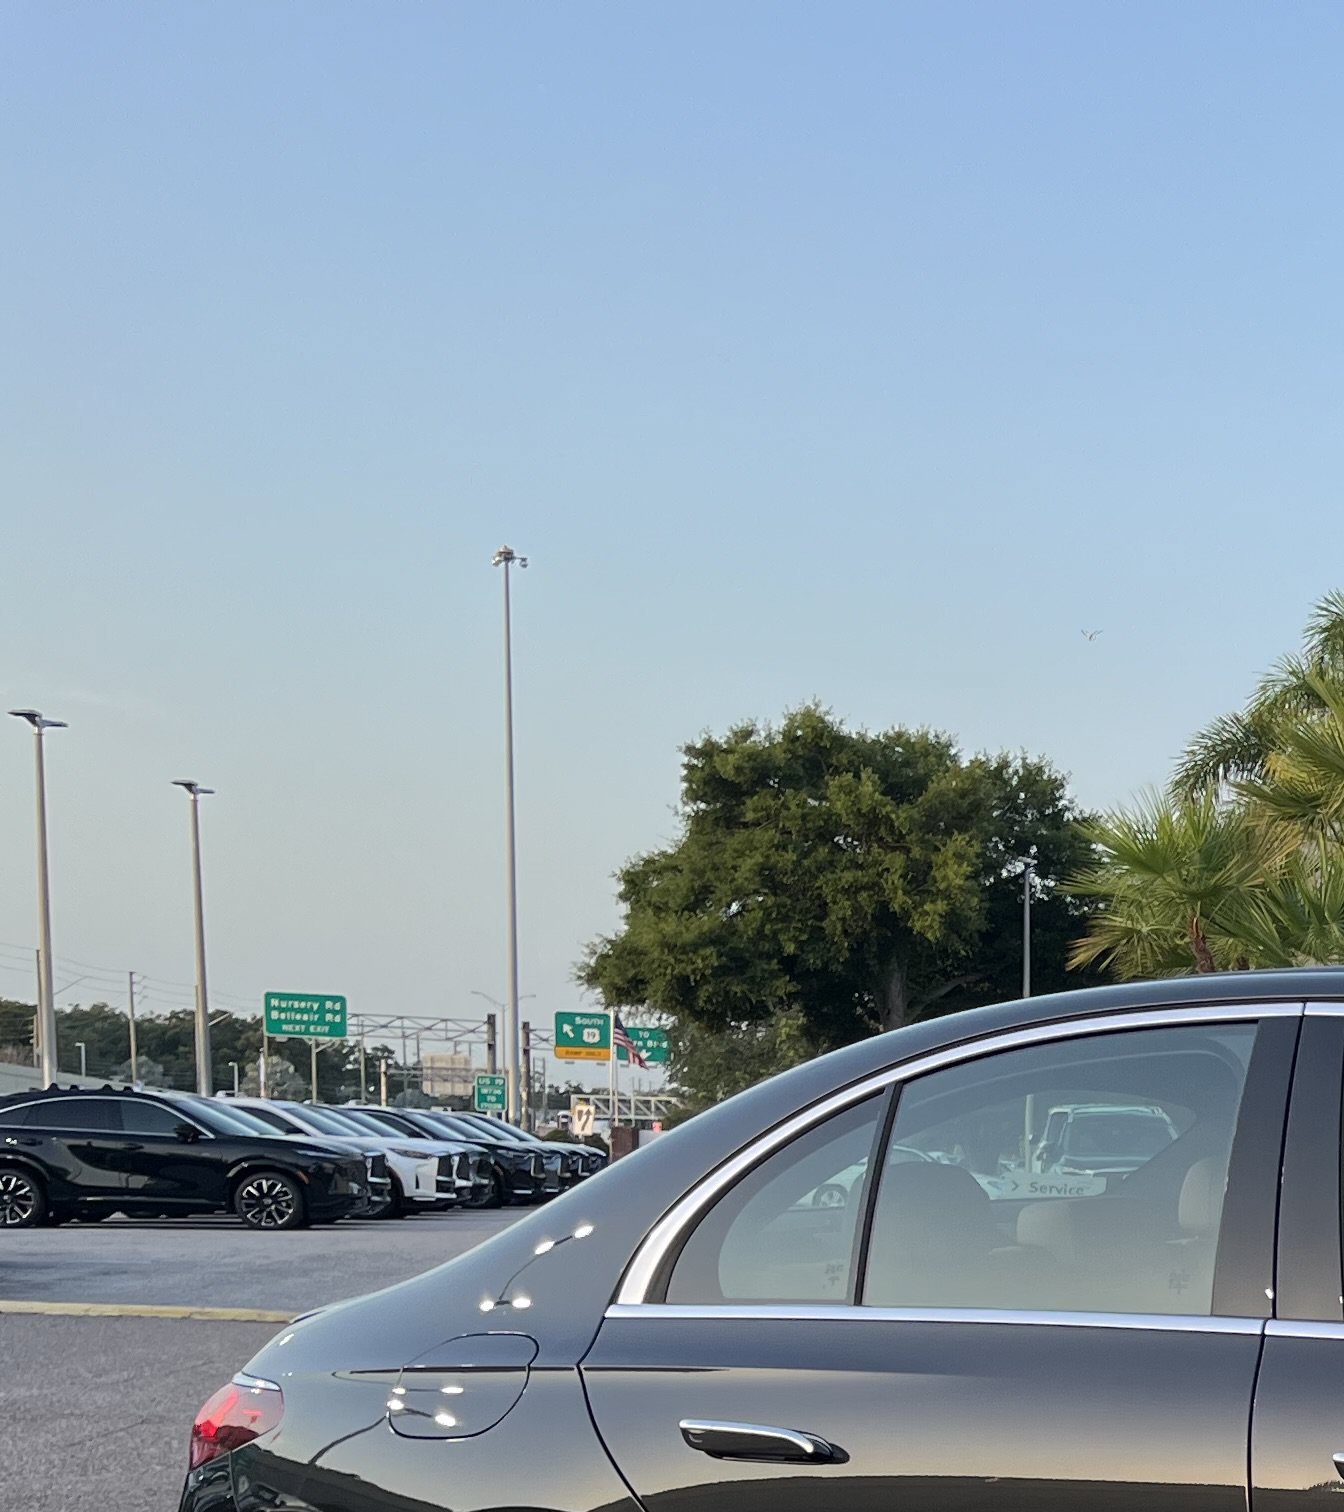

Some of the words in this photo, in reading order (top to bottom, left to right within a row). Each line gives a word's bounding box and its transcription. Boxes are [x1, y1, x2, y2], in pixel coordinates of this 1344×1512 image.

[271, 998, 319, 1011] Nursery
[325, 1001, 341, 1010] Rd
[325, 1013, 341, 1022] Rd
[586, 1031, 597, 1040] 19
[1029, 1182, 1084, 1195] Service
